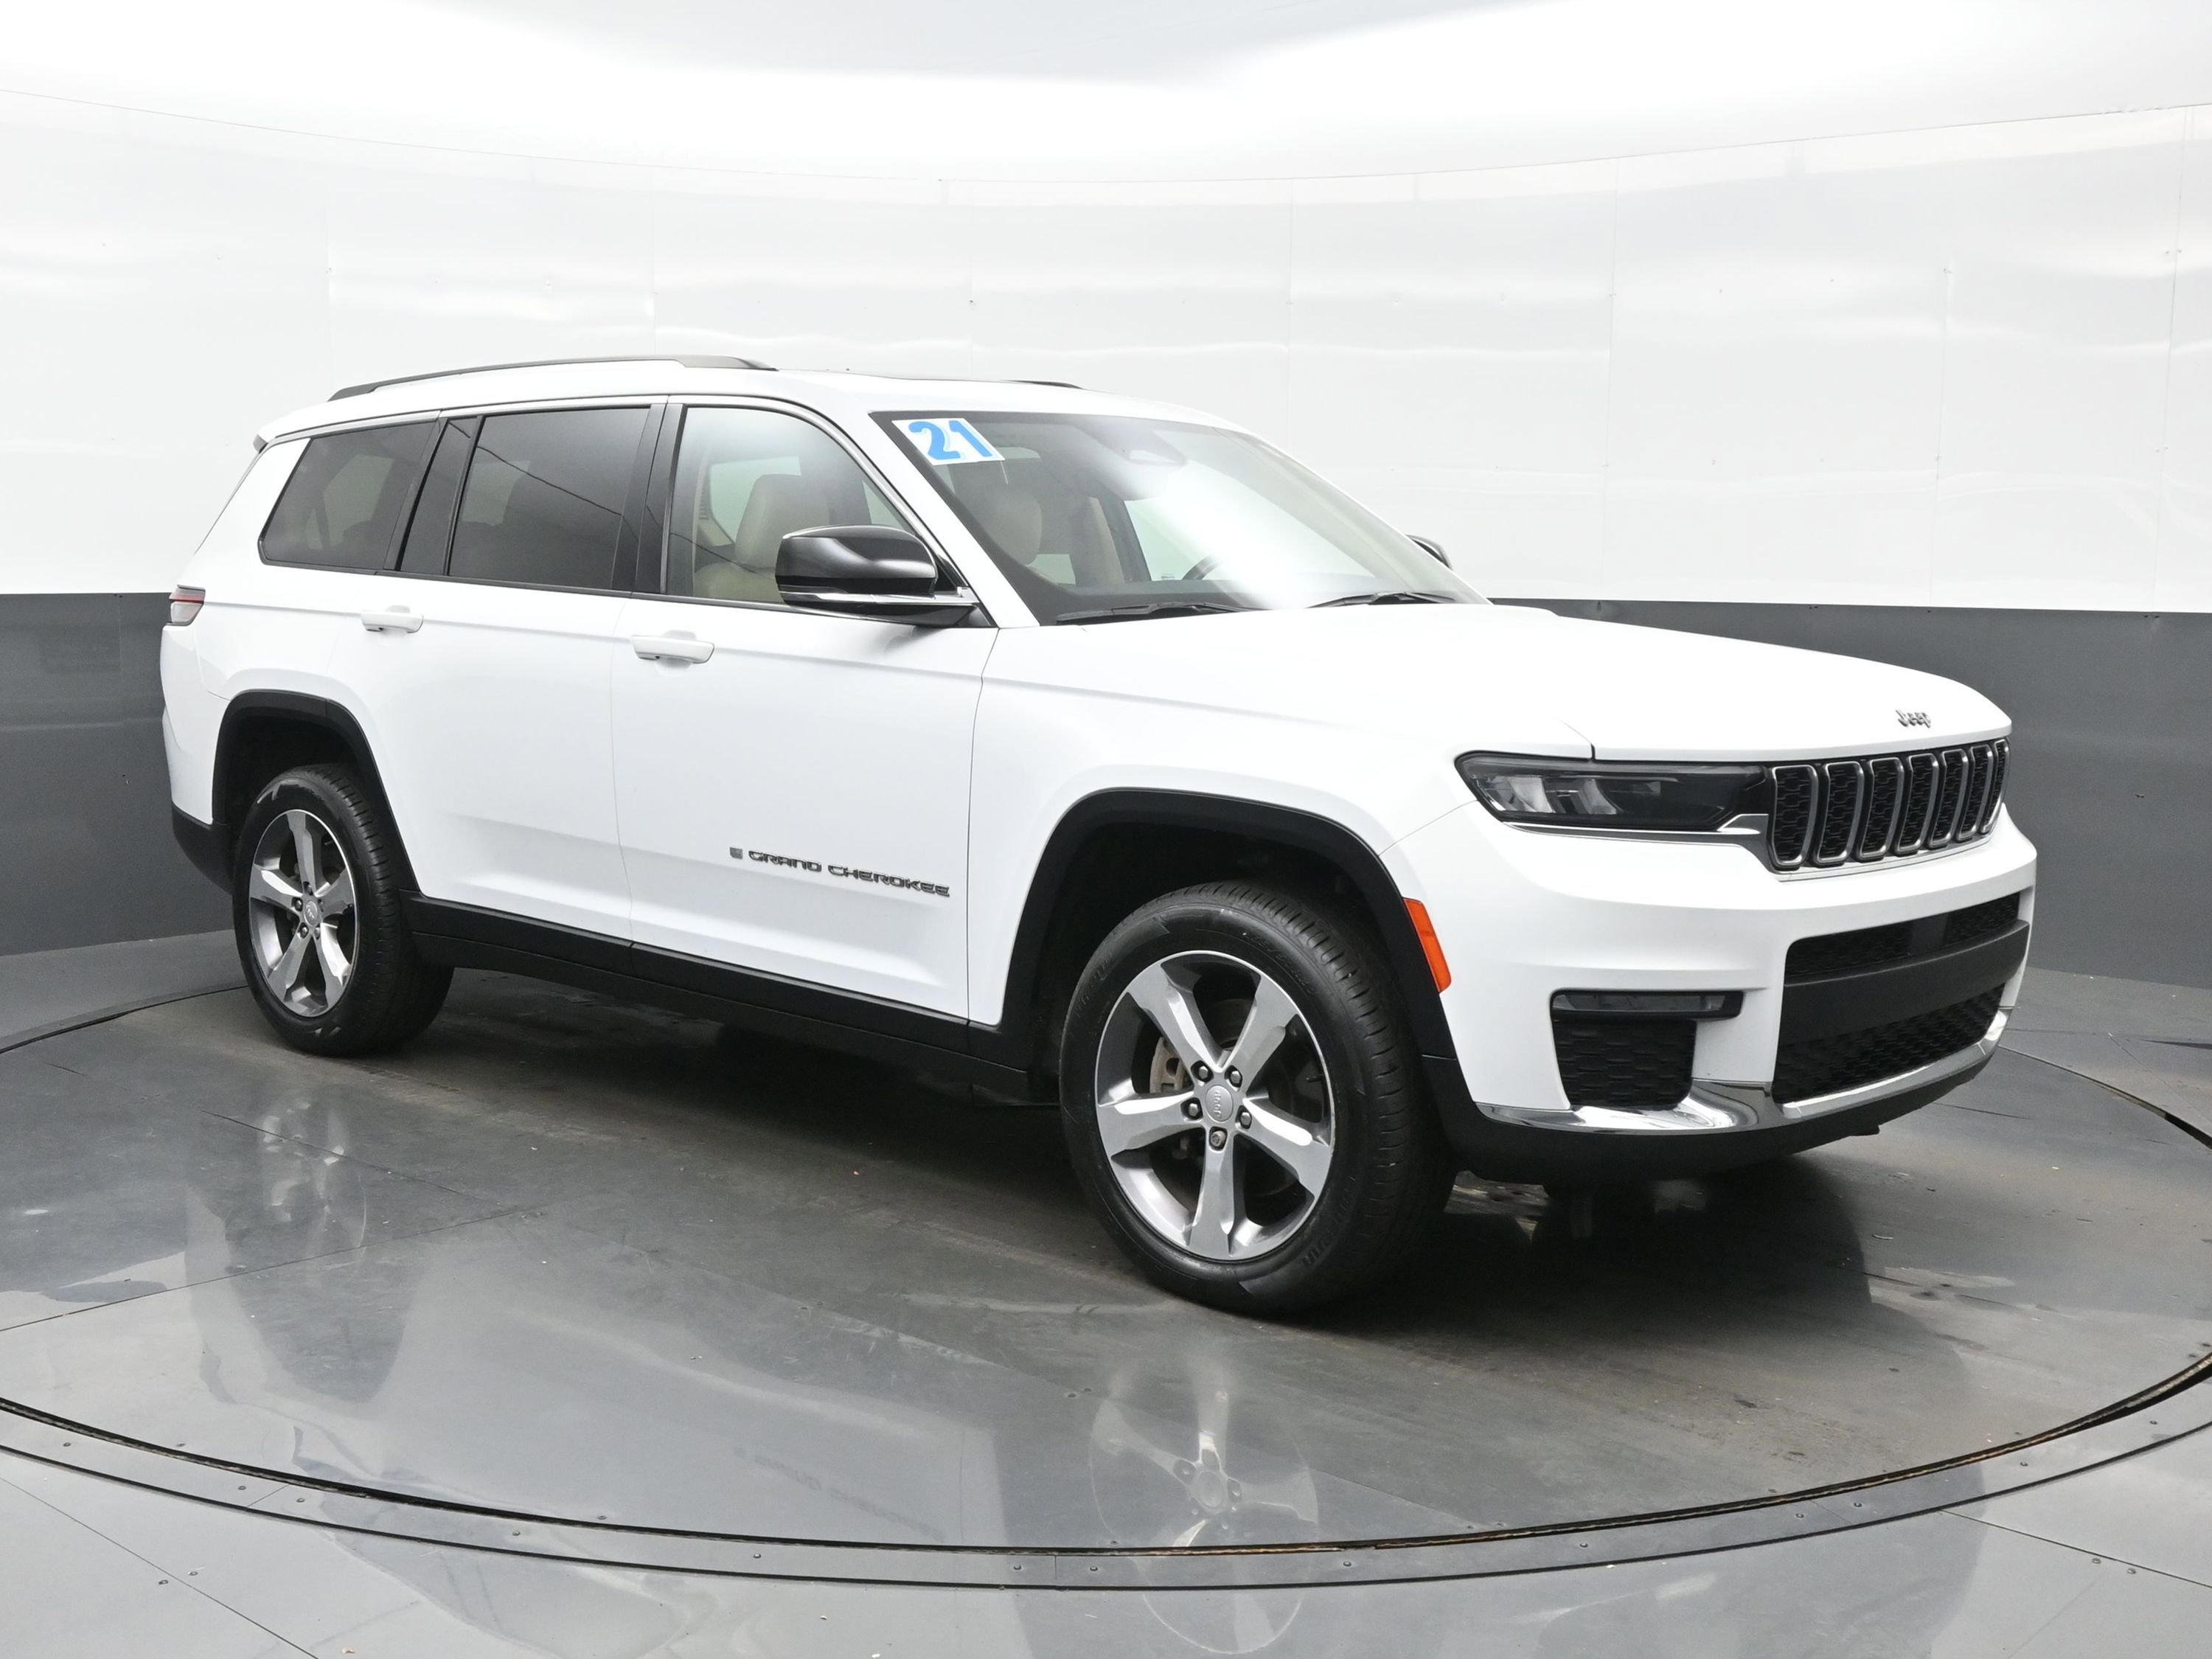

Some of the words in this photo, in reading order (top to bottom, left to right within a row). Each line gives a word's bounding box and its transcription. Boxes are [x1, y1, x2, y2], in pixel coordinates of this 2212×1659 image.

[908, 420, 992, 461] 21
[1895, 709, 1931, 728] Jeep
[748, 850, 821, 872] GRAND
[828, 865, 950, 897] CHEROKEE
